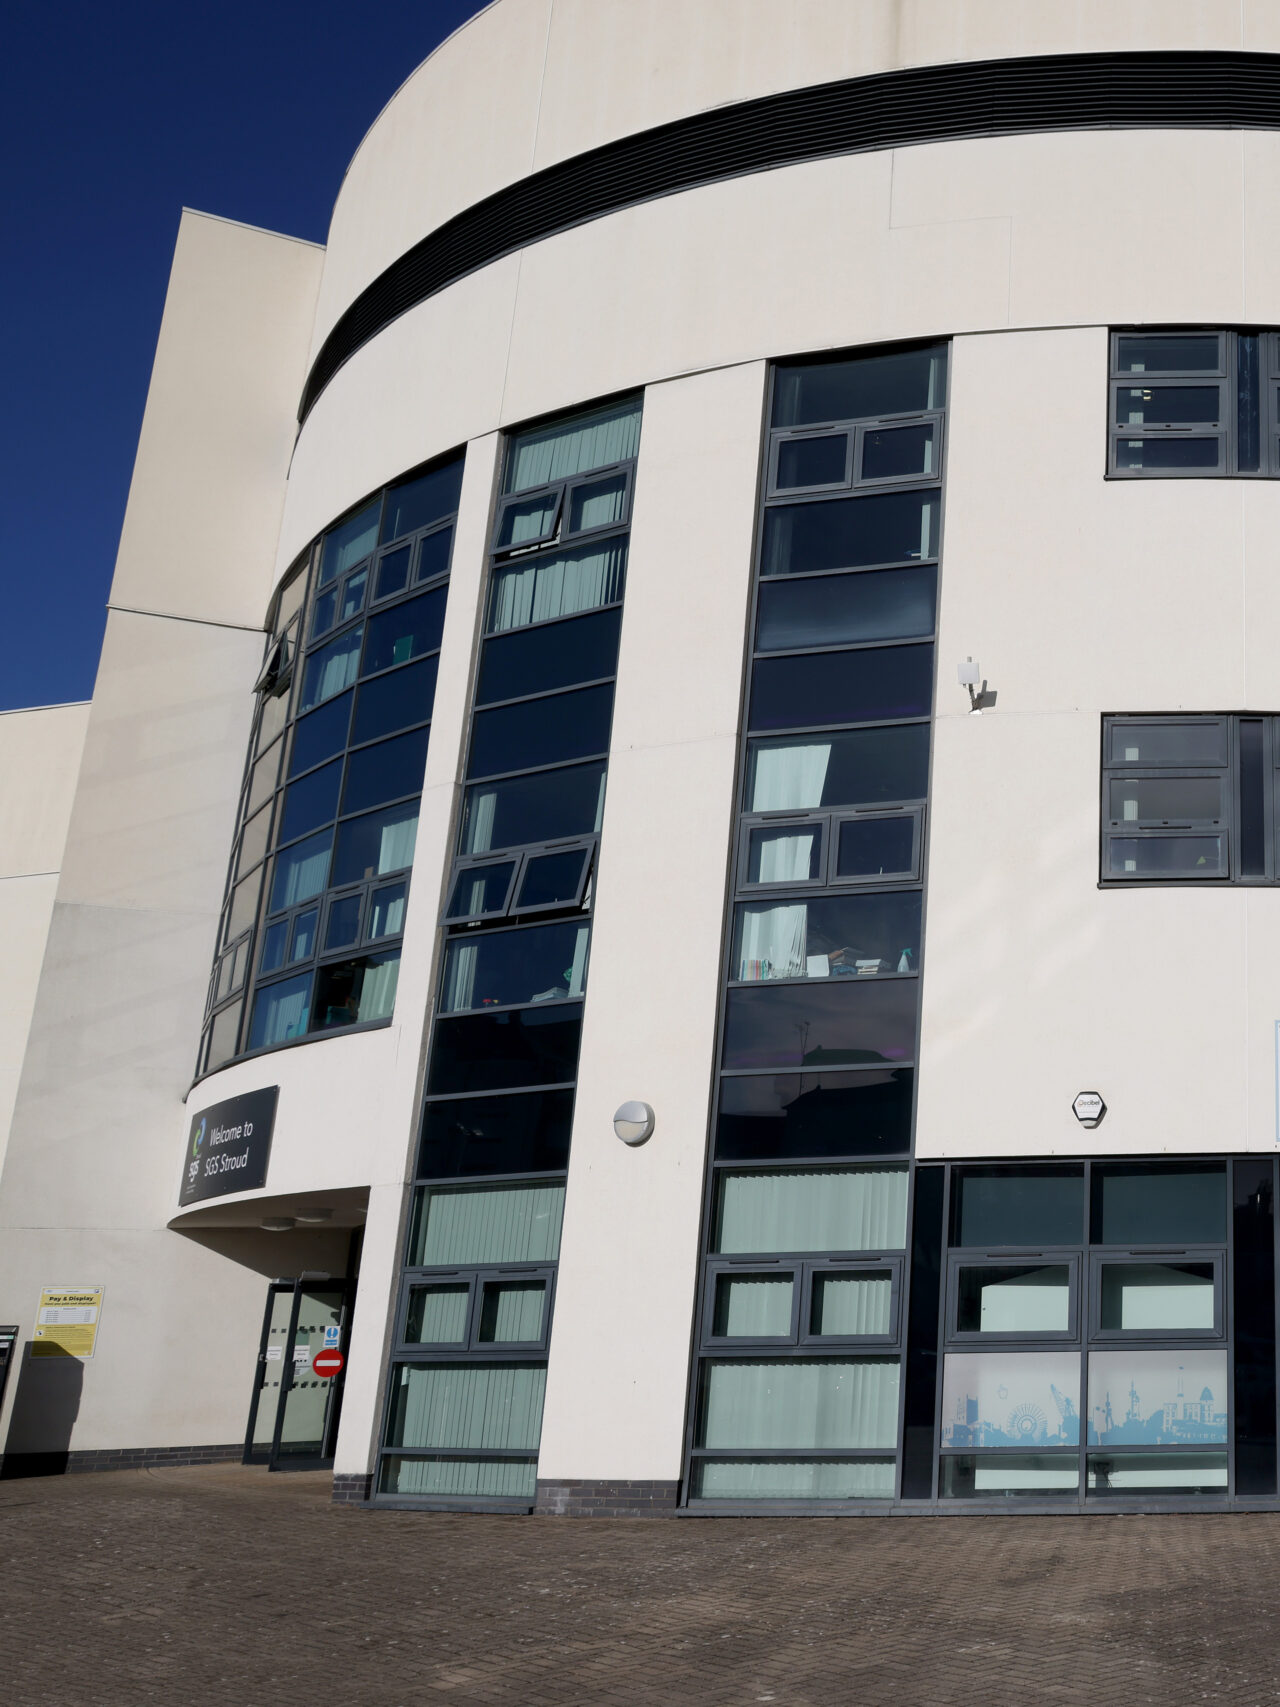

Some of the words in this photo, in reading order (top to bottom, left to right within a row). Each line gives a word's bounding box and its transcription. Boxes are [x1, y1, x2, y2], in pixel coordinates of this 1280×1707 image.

[209, 1124, 242, 1147] Welcome
[243, 1120, 254, 1137] to
[204, 1155, 220, 1177] SGS
[219, 1146, 250, 1173] Stroud
